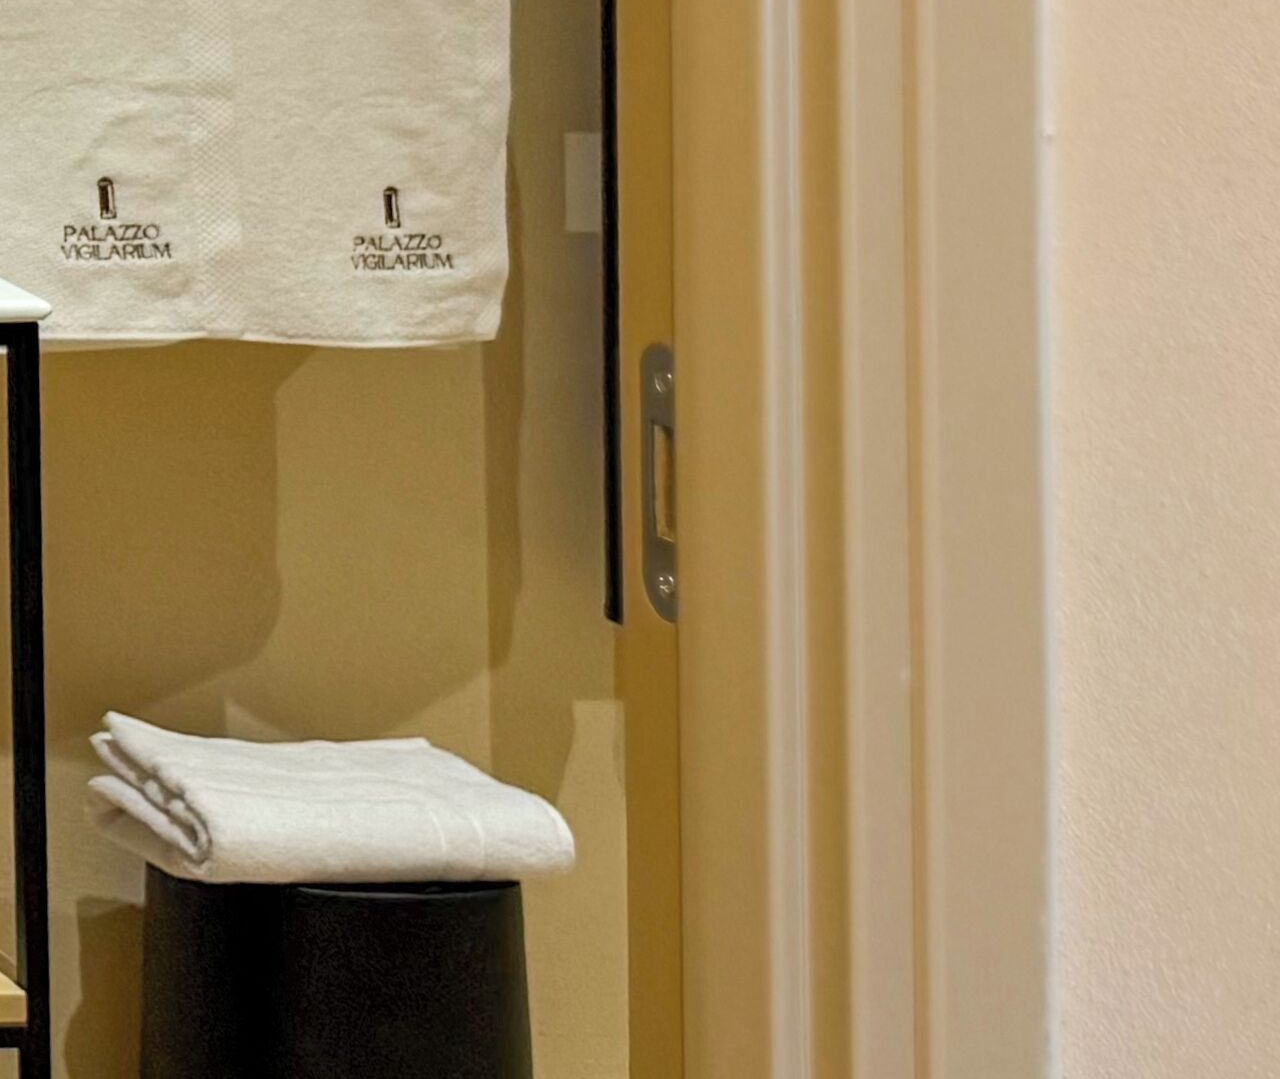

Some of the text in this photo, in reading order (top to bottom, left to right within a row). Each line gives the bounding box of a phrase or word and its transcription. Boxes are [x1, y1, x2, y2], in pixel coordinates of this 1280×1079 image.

[63, 223, 160, 242] PALAZZO
[60, 241, 172, 261] VIGILARIUM
[353, 233, 442, 252] PALAZZO
[350, 252, 454, 271] VIGILARIUM
